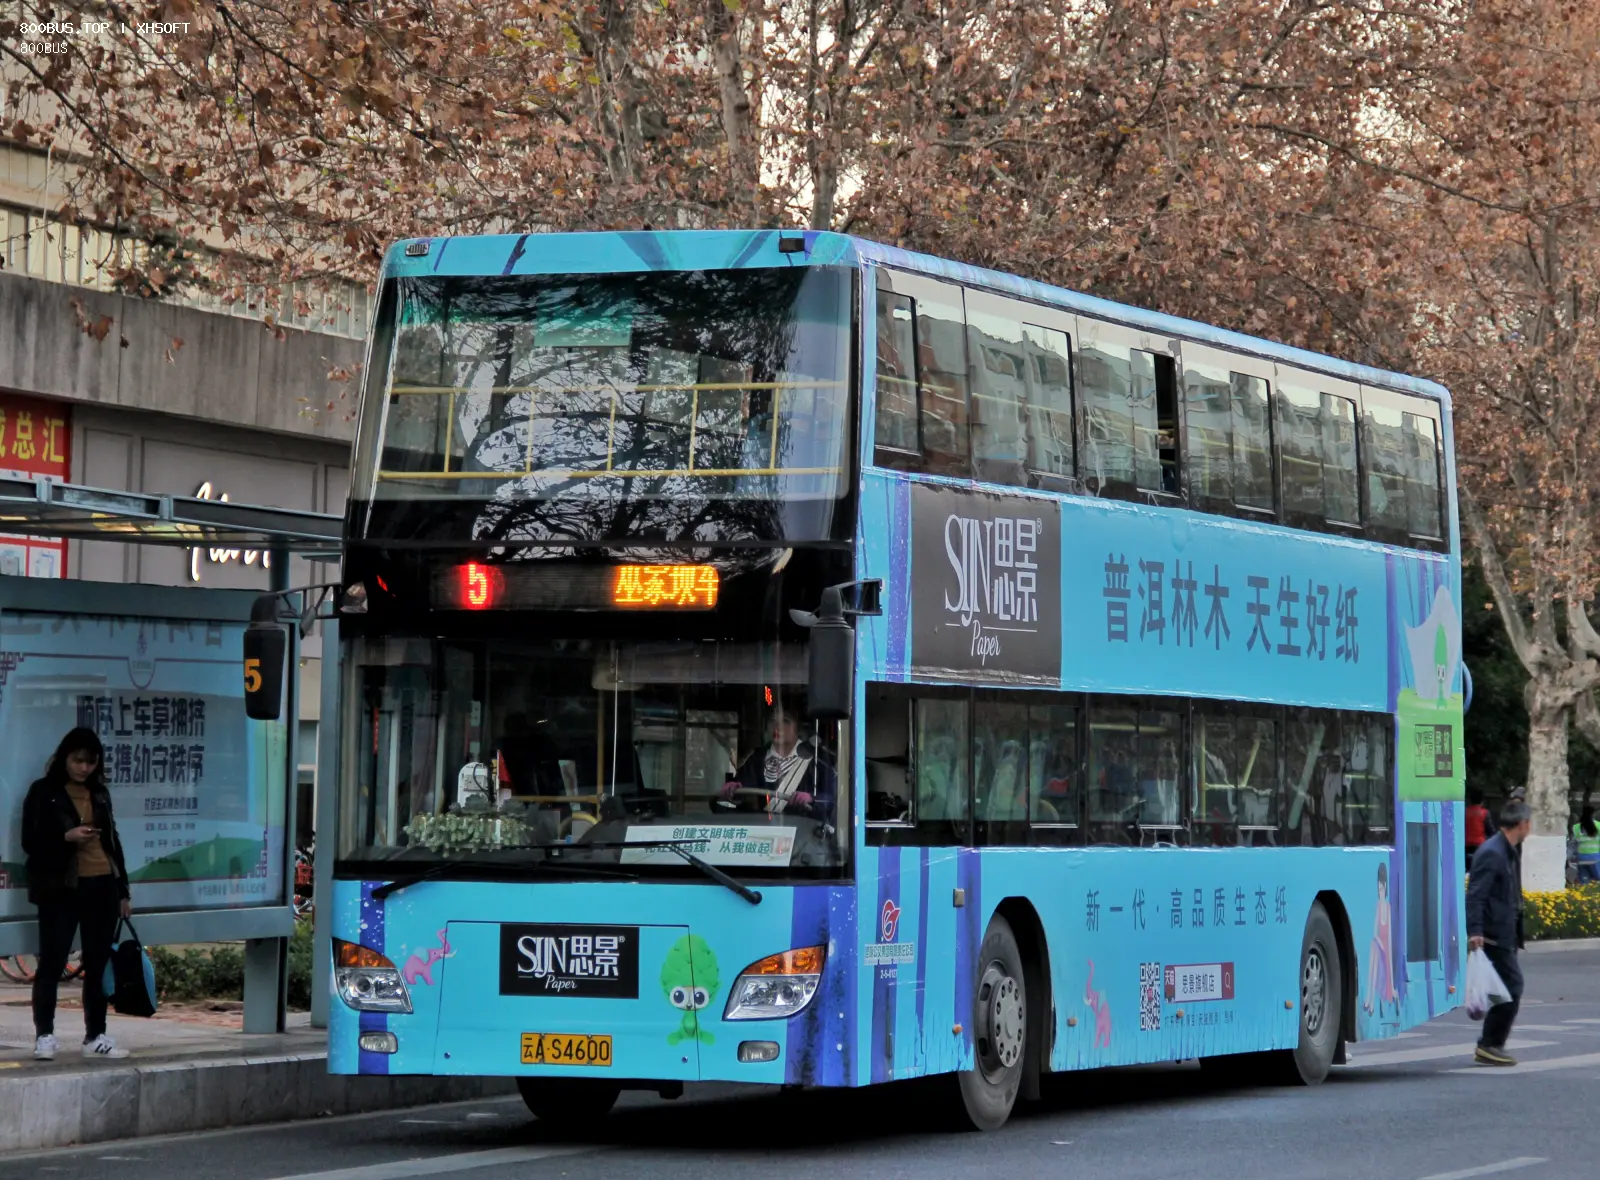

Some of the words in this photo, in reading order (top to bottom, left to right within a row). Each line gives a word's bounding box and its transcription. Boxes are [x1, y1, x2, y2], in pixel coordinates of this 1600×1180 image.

[467, 563, 489, 605] 5
[993, 517, 1039, 622] 思景
[1102, 552, 1231, 650] 普洱林木
[1246, 574, 1360, 664] 天生好纸
[970, 619, 1001, 667] Paper
[243, 658, 263, 692] 5
[672, 828, 748, 840] 创建文明城市
[569, 935, 620, 977] 思景
[544, 974, 577, 992] Paper
